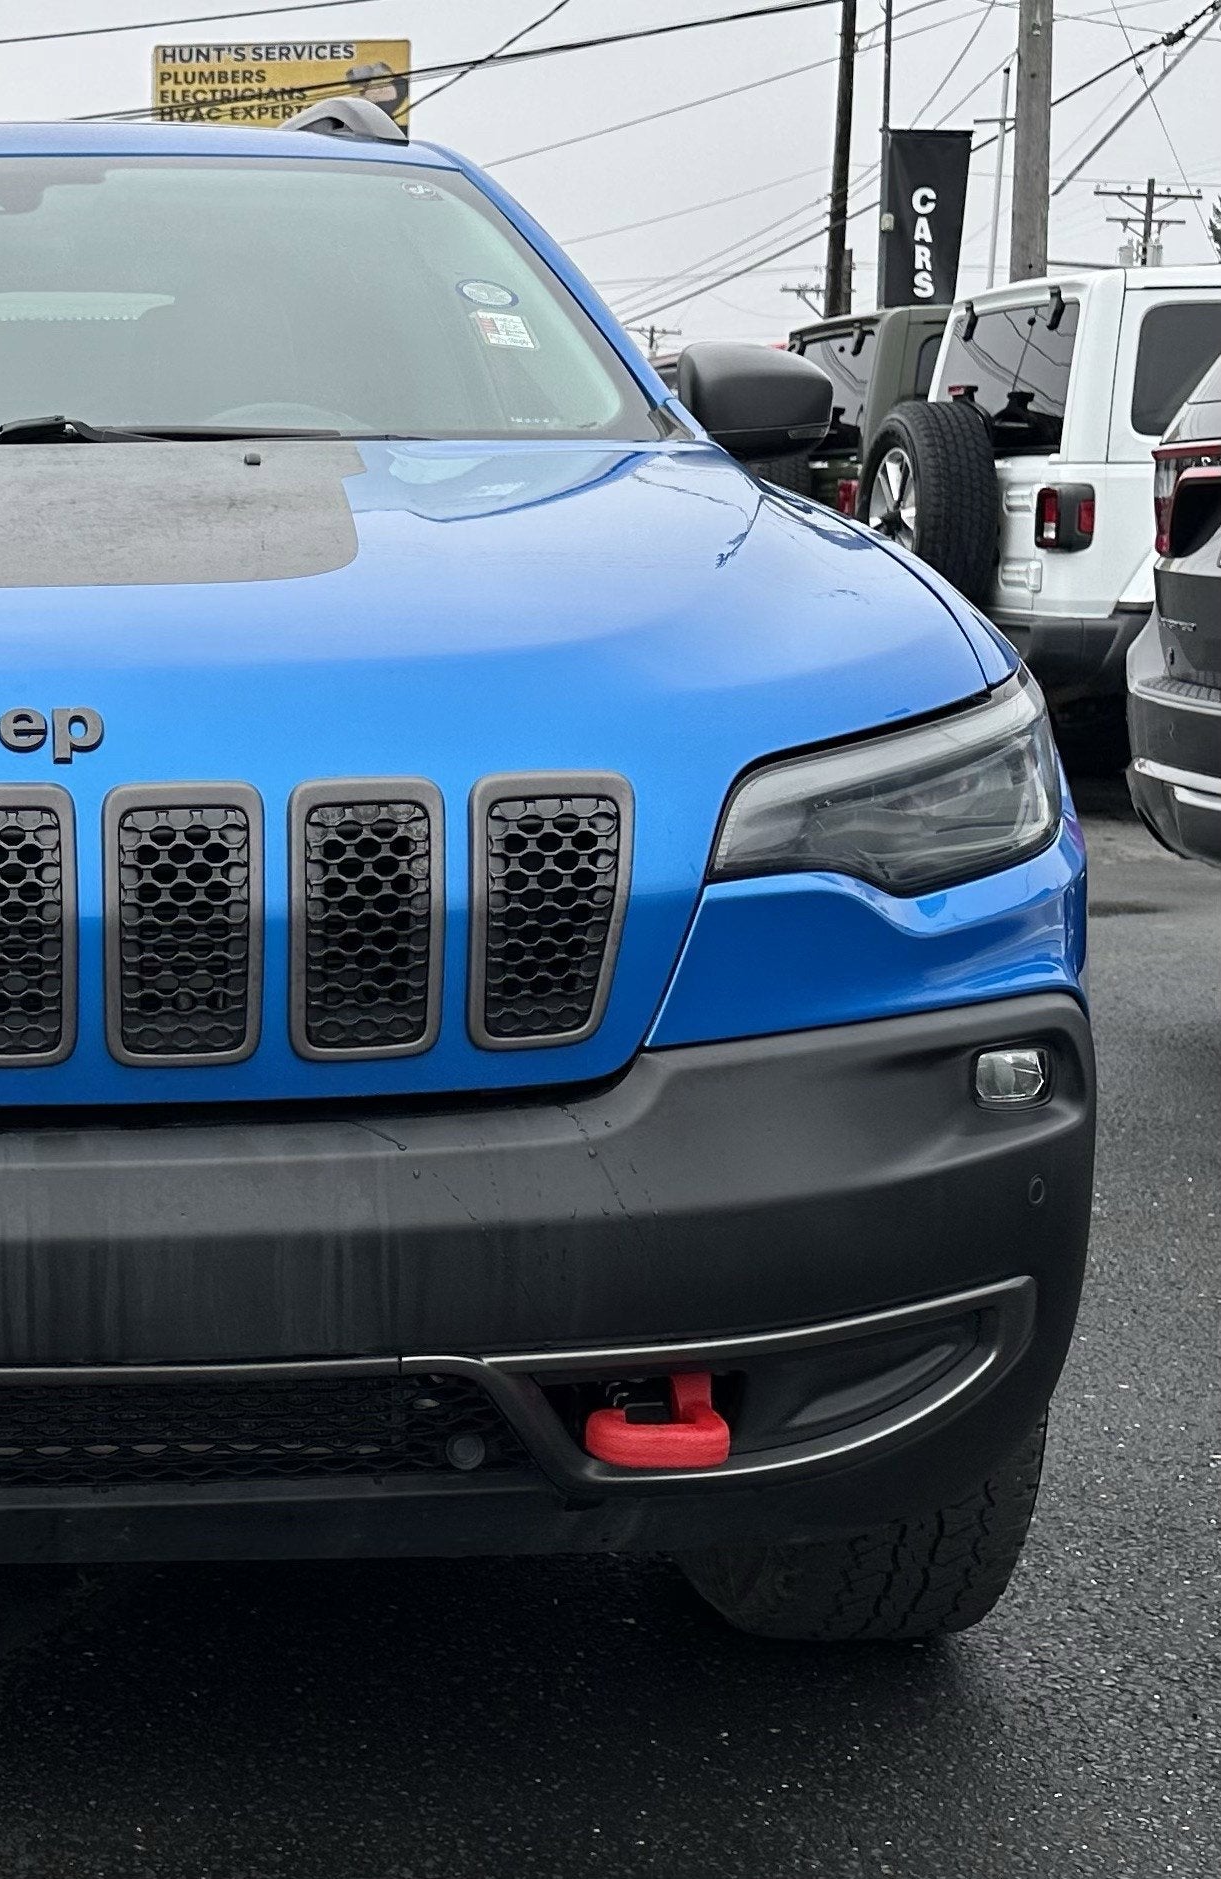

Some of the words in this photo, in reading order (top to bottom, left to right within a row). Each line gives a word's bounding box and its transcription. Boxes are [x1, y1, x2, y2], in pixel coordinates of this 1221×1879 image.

[162, 46, 246, 64] HUNT'S
[251, 44, 355, 61] SERVICES
[160, 70, 266, 85] PLUMBERS
[160, 87, 307, 104] ELECTRICIANS
[231, 104, 312, 121] EXPERT
[912, 187, 937, 298] CARS
